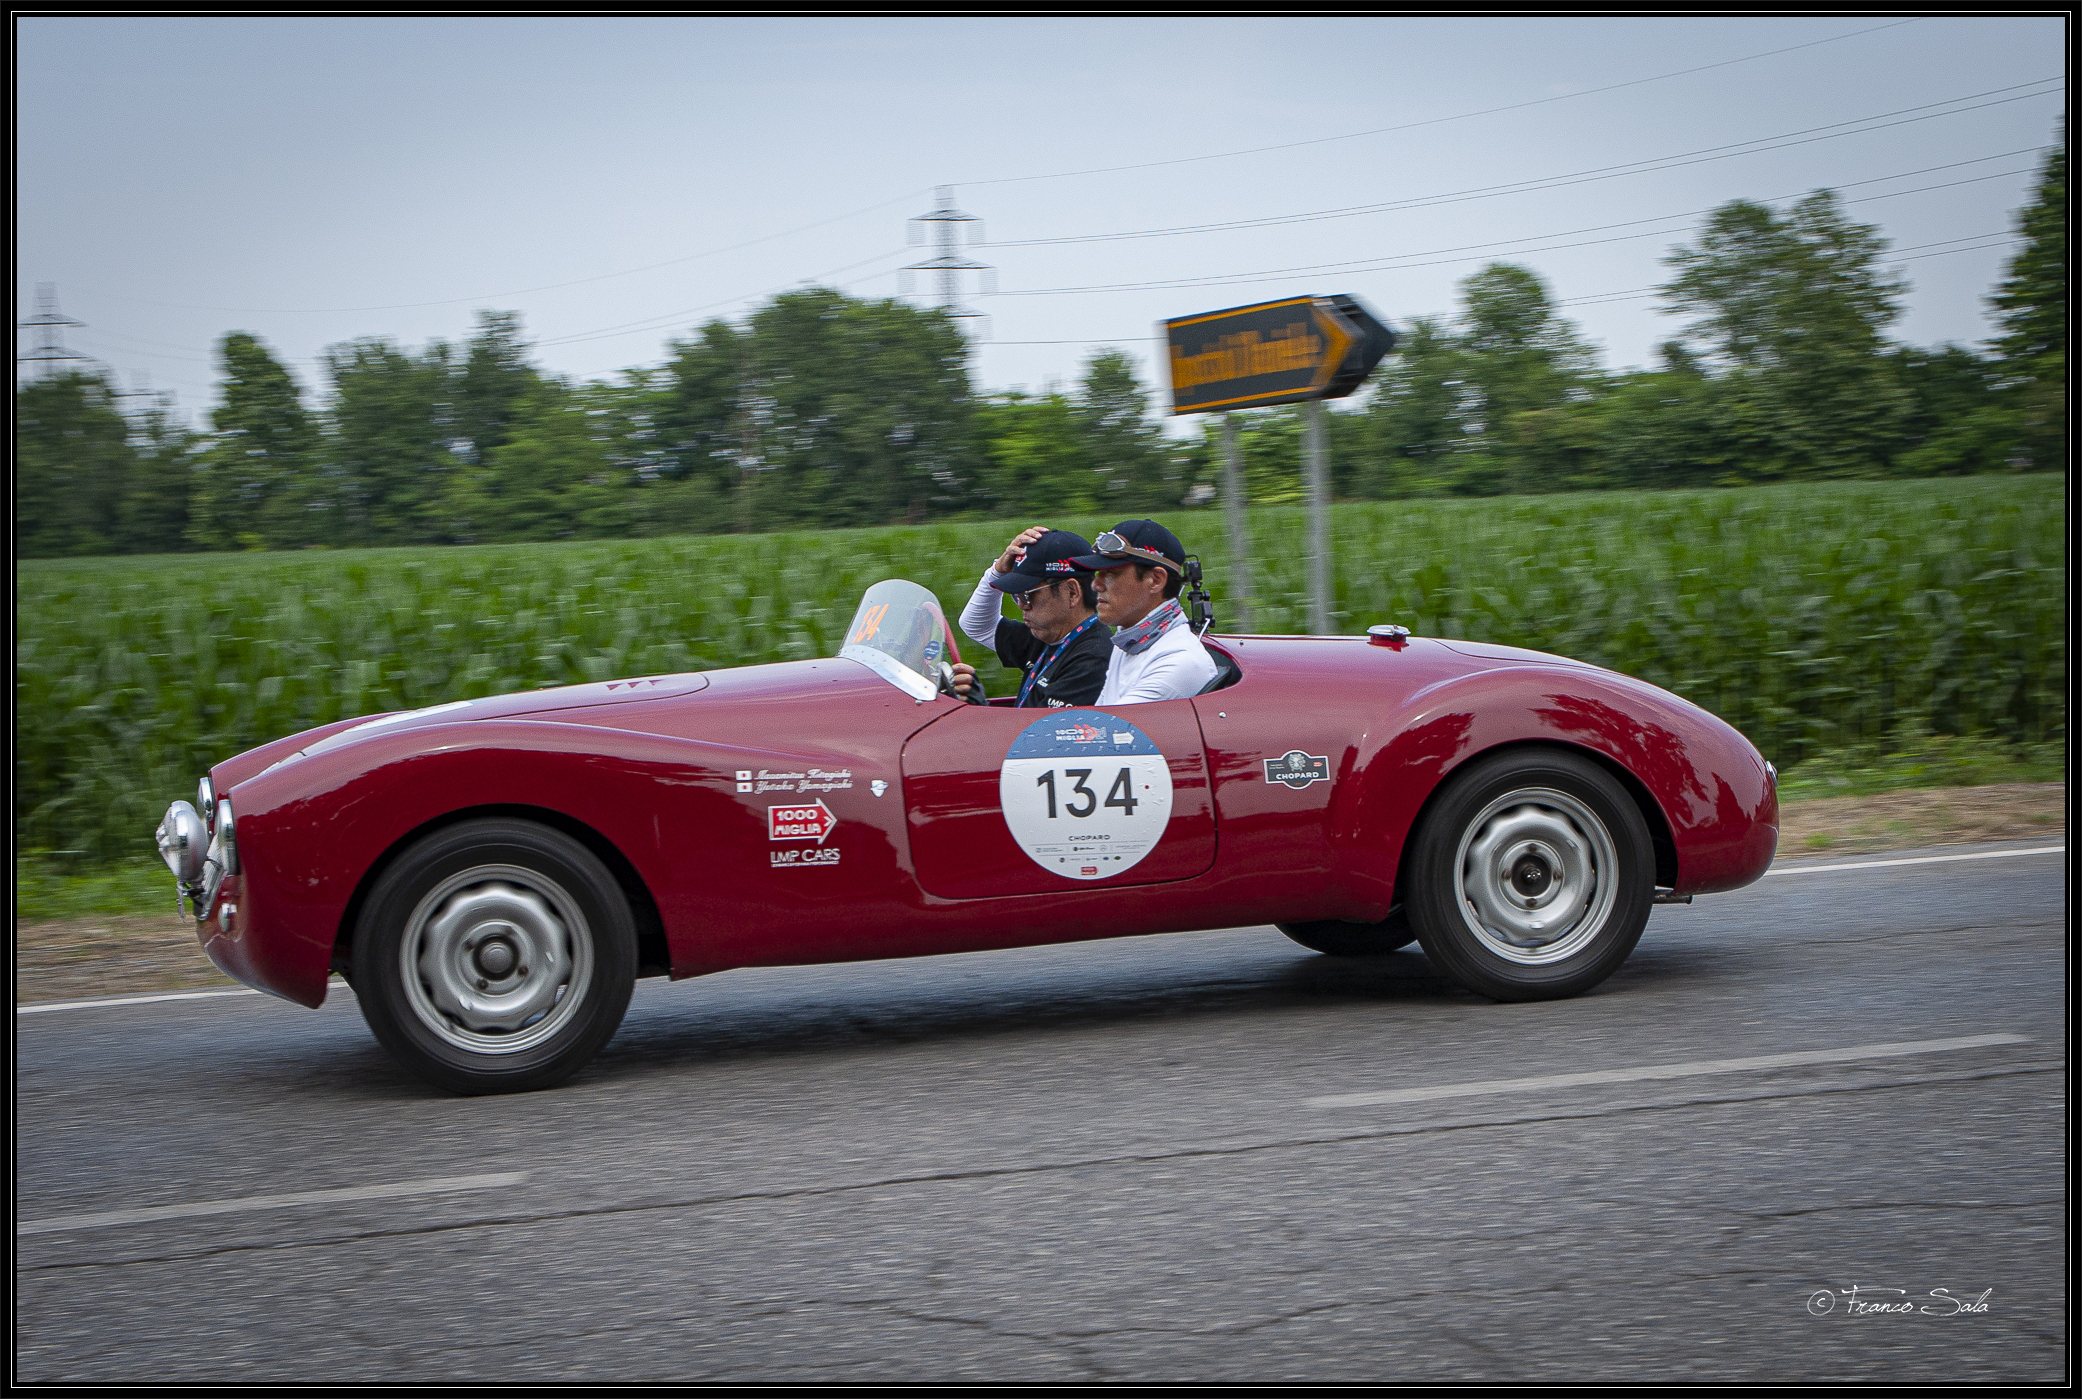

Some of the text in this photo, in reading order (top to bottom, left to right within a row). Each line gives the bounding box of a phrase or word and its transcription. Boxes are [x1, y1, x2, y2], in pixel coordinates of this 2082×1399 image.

[1275, 771, 1319, 779] CHOPARD
[1037, 768, 1138, 818] 134
[776, 809, 818, 821] 1000
[774, 823, 822, 835] MIGLIA
[1068, 834, 1111, 842] CHOPARD
[770, 848, 841, 863] LMP CARS
